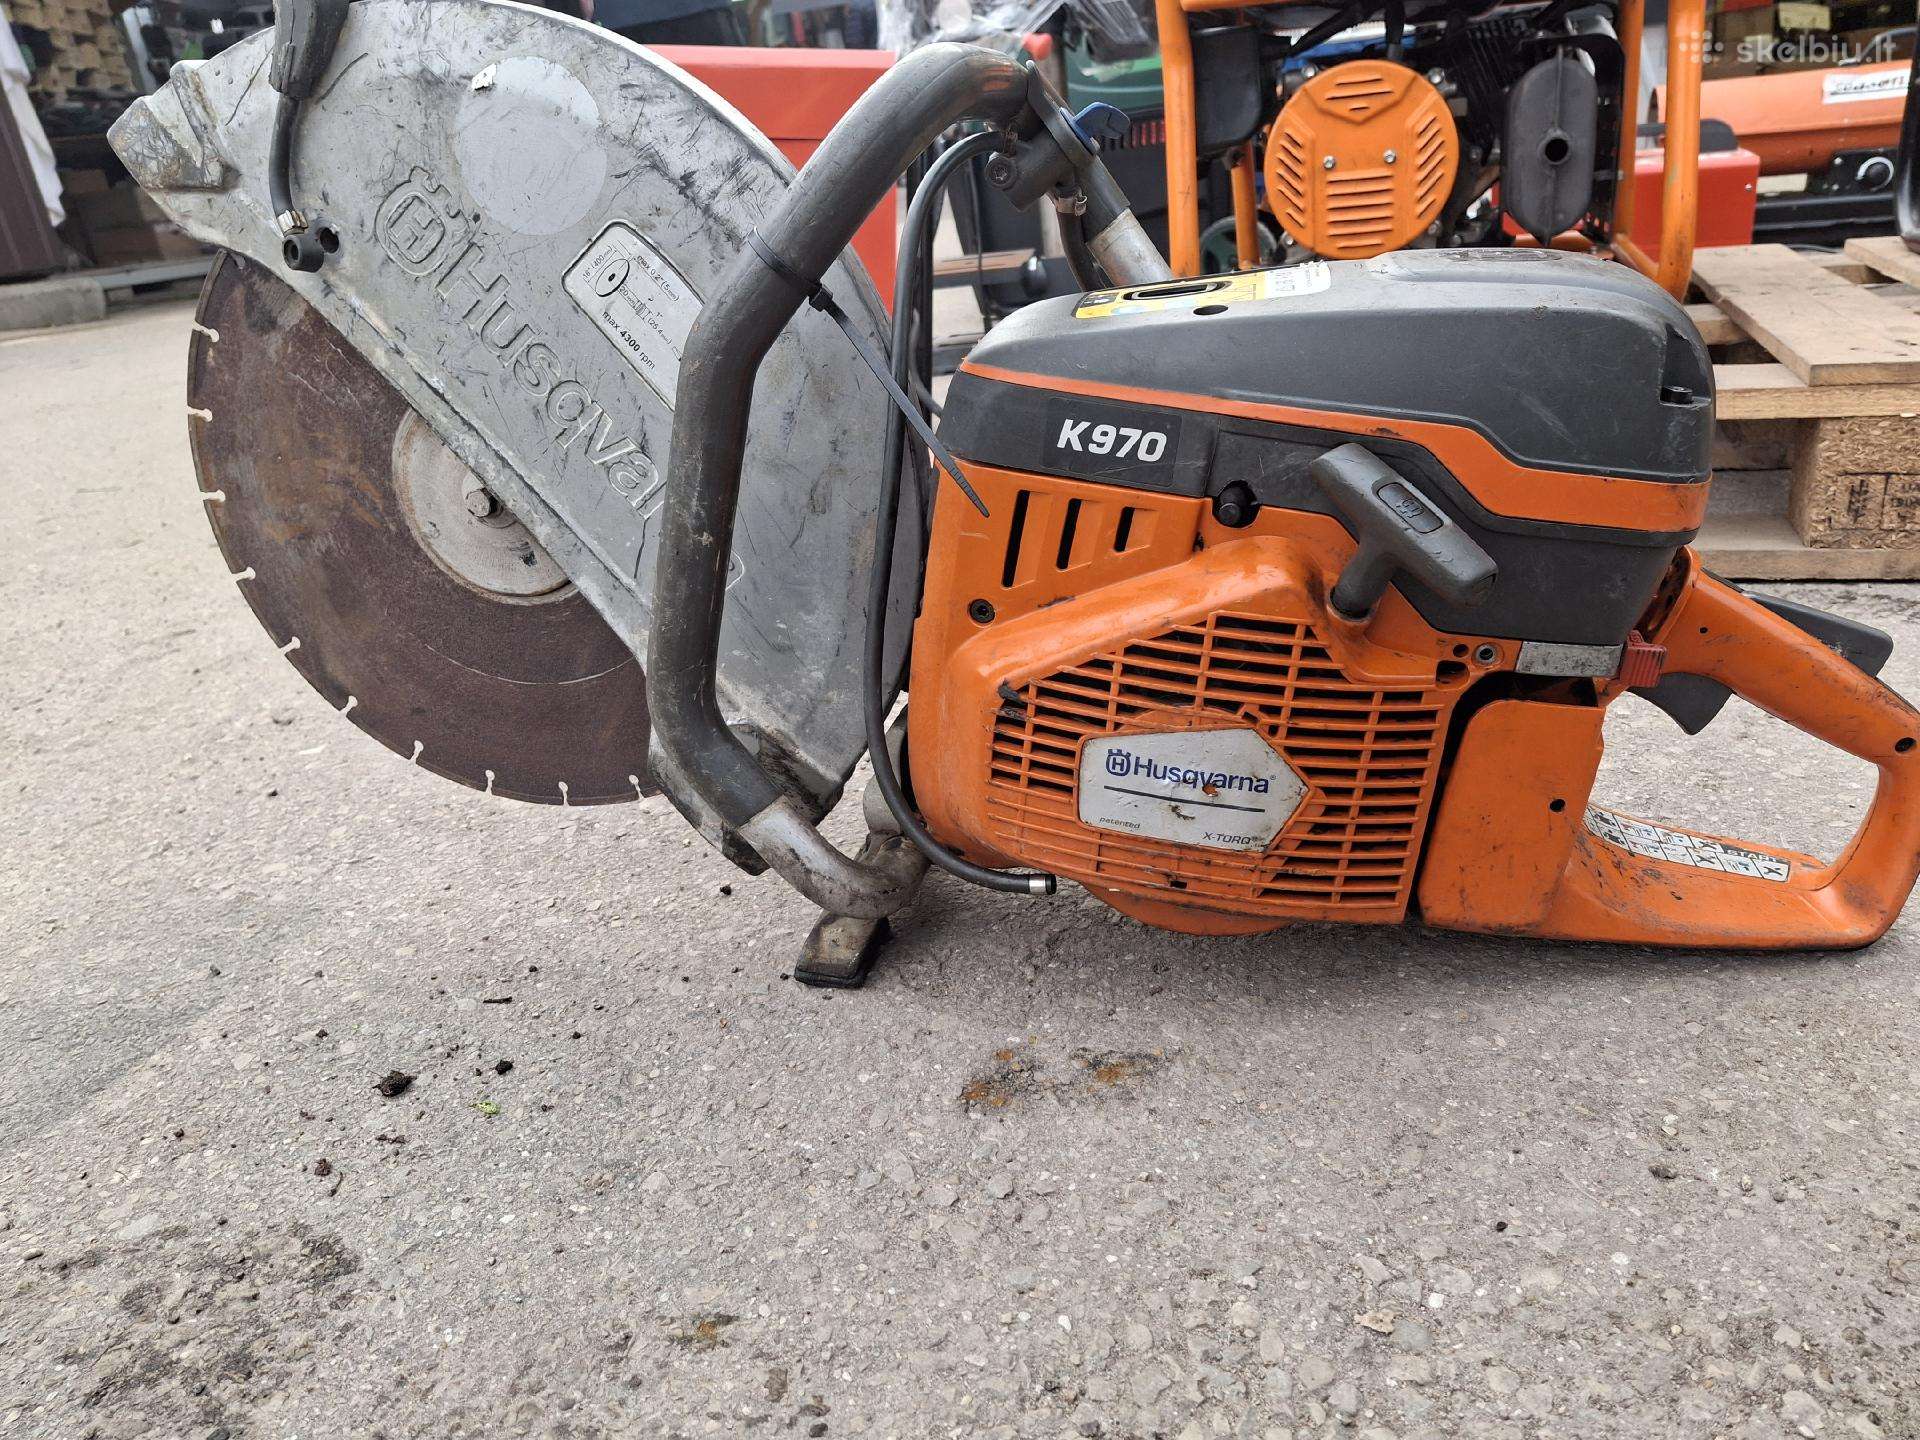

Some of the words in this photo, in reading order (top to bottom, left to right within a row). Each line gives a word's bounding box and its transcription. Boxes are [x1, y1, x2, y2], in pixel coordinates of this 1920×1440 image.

[602, 311, 620, 332] max
[620, 329, 641, 352] 4300
[639, 352, 655, 369] rpm
[1134, 756, 1269, 793] Husqvarna
[1099, 816, 1141, 829] patented
